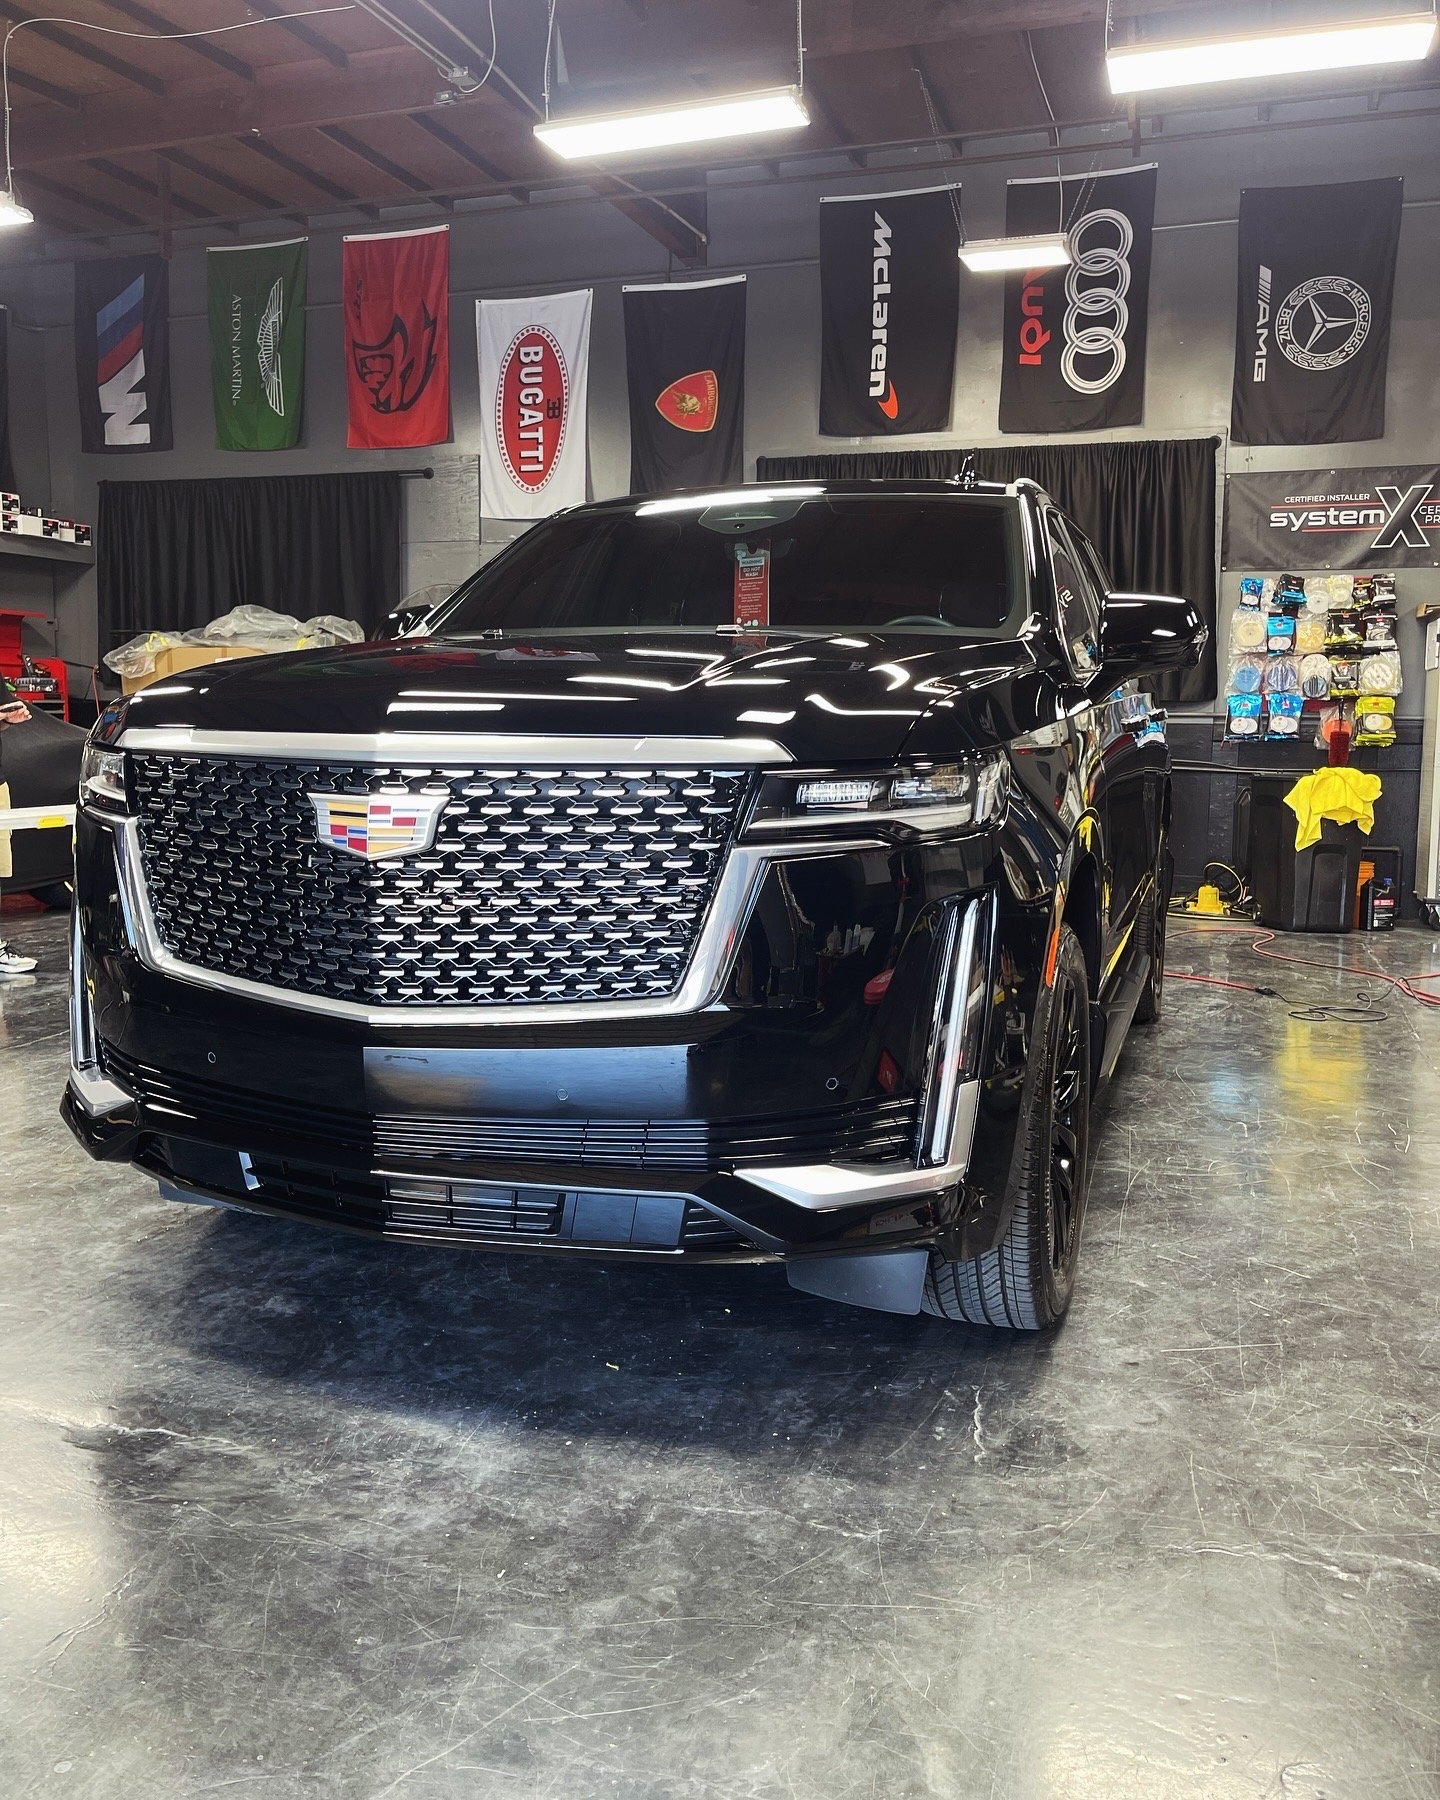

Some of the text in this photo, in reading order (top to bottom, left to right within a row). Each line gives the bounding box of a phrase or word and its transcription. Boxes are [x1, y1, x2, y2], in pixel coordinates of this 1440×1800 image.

[868, 210, 893, 397] McLaren
[1253, 299, 1270, 382] AMG
[1278, 307, 1293, 344] BENZ
[1345, 287, 1369, 355] MERCEDES
[231, 294, 242, 400] ASTON MARTIN
[518, 345, 545, 473] BUGATTI
[1284, 493, 1370, 504] CERTIFIED INSTALLER
